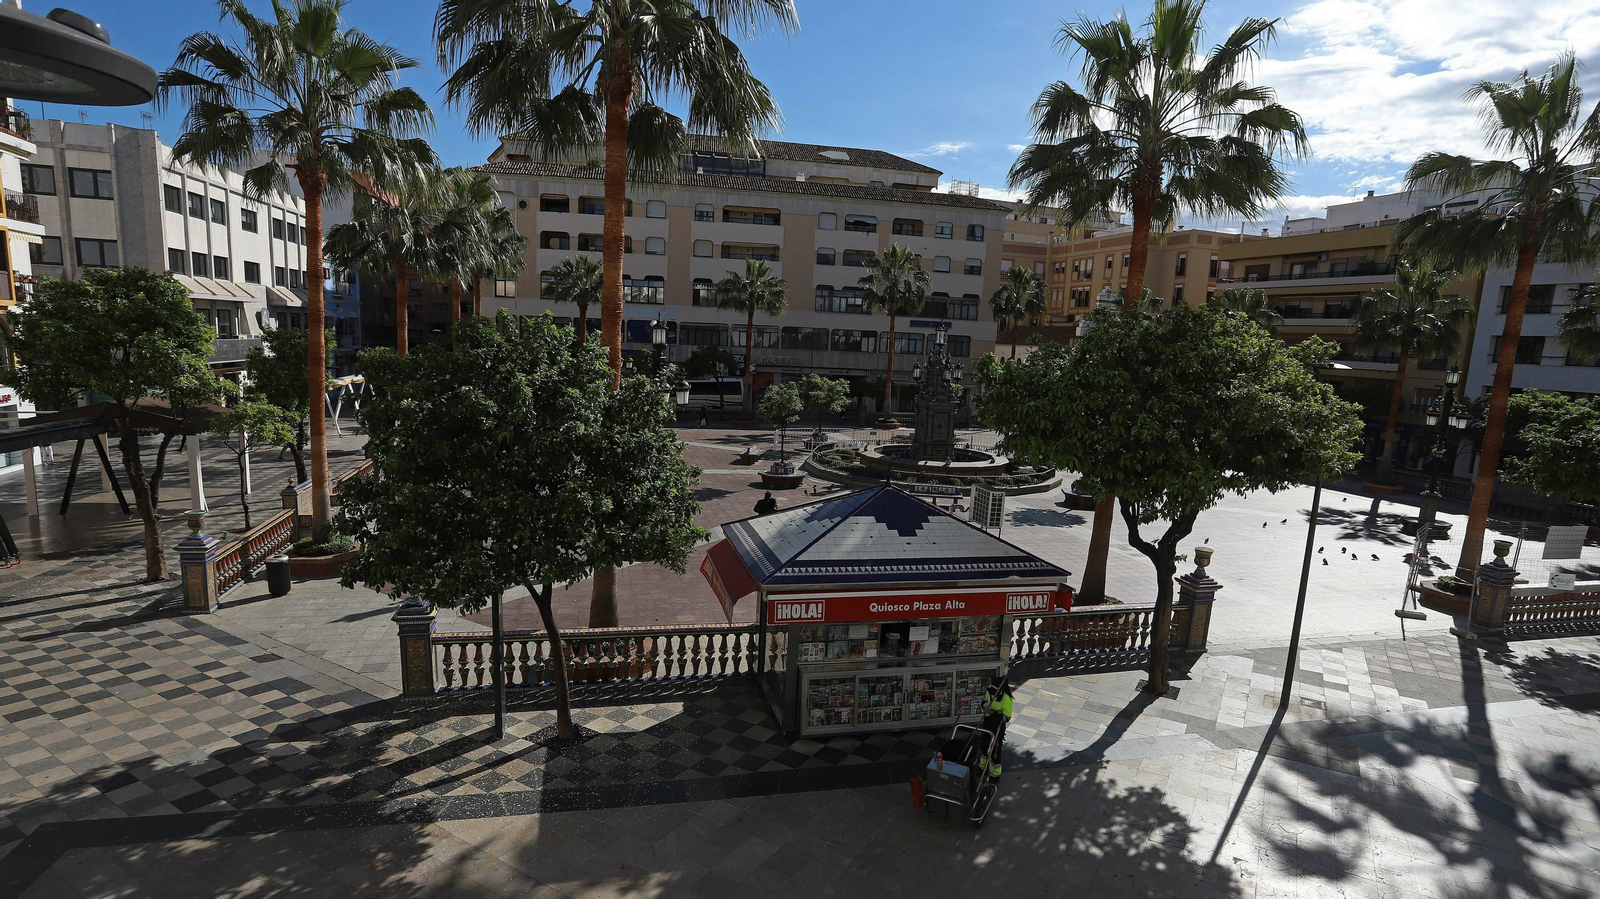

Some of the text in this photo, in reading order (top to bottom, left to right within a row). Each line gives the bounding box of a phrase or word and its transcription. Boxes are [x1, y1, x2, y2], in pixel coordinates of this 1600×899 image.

[869, 600, 966, 613] Quiosco Plaza Alta
[1008, 595, 1048, 610] ¡HOLA!
[777, 603, 823, 619] ¡HOLA!
